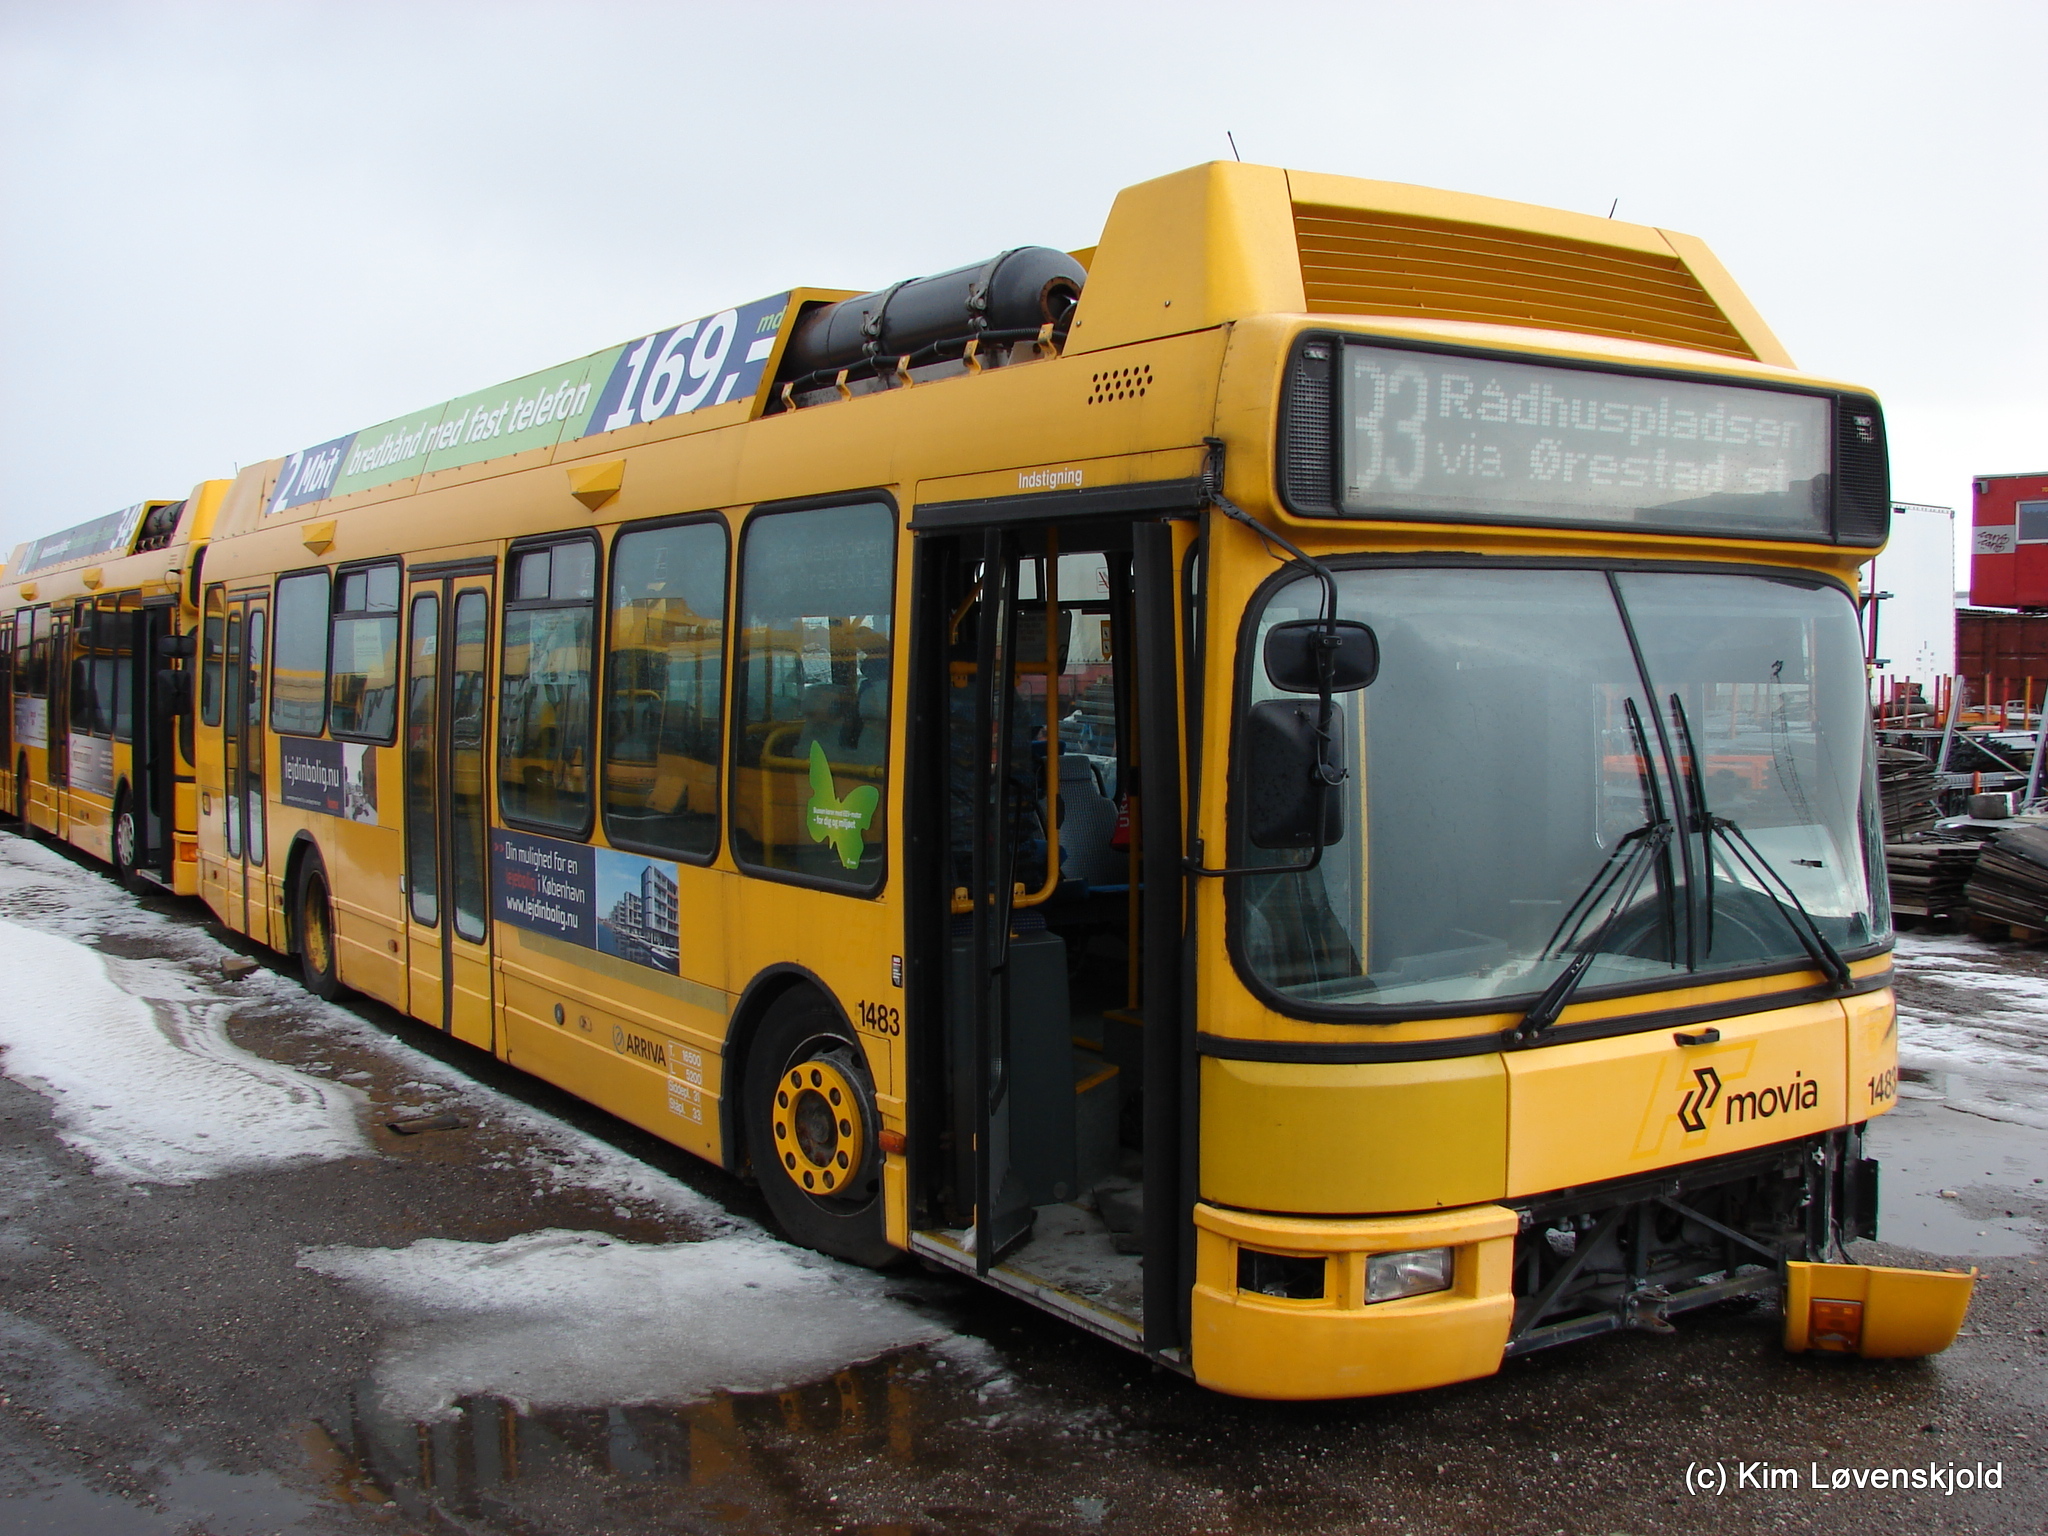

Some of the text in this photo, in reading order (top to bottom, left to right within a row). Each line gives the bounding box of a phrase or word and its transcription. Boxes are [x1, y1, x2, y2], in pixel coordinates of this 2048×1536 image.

[271, 379, 592, 514] 2 Mbit bredbånd med fast telefon
[1437, 432, 1504, 478] via
[1529, 438, 1725, 492] Ørestad
[1018, 467, 1083, 489] Indstigning
[284, 754, 340, 793] lejdinbolig.nu
[505, 841, 578, 875] Din mulighed for en
[541, 874, 586, 904] København
[506, 895, 579, 931] www.lejdinbolig.nu
[858, 999, 900, 1037] 1483
[626, 1033, 667, 1067] ARRIVA
[1725, 1069, 1818, 1125] movia
